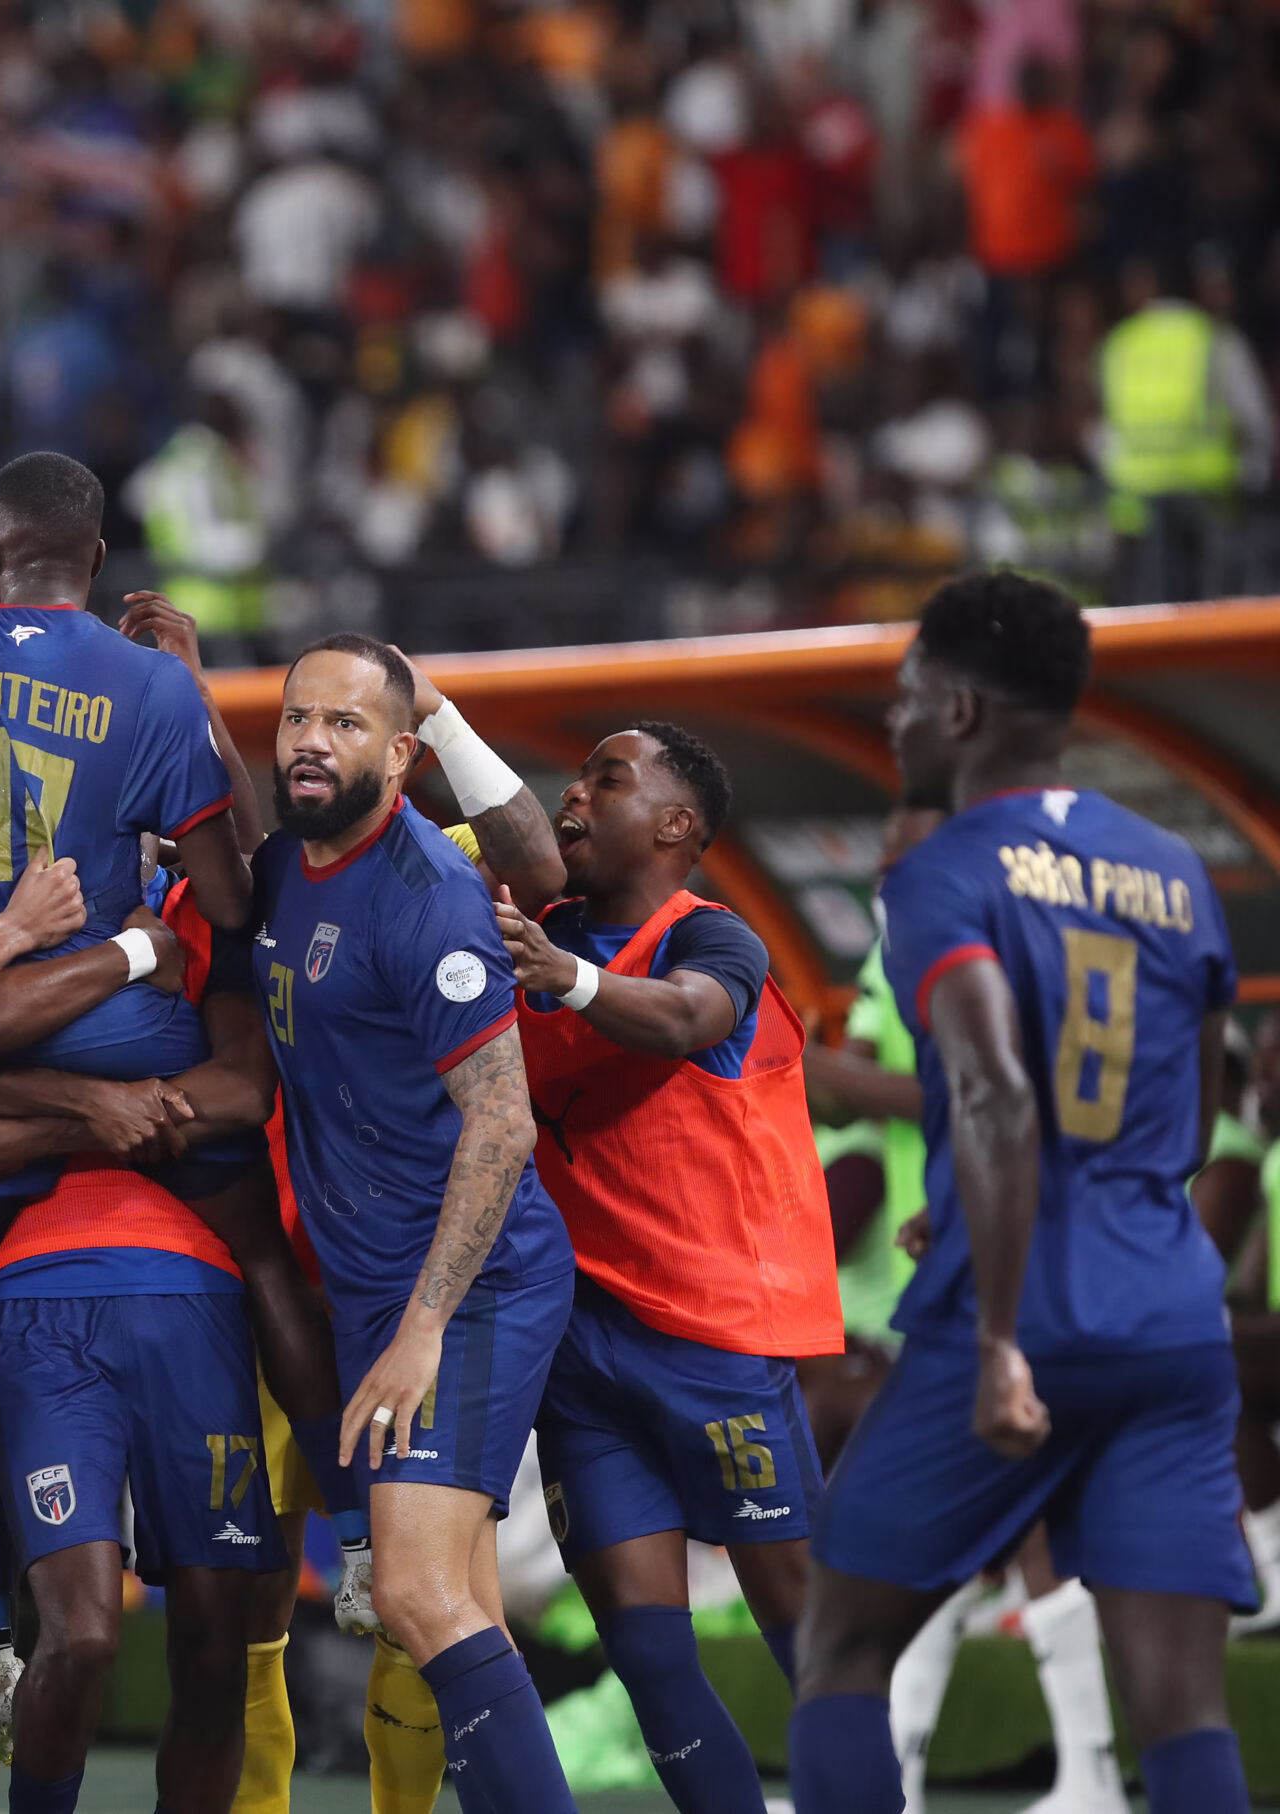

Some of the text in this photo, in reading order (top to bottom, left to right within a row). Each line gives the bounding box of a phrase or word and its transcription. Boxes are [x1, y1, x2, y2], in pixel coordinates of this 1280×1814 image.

[316, 926, 338, 938] FCF
[268, 961, 294, 1047] 21
[1054, 925, 1138, 1143] 8
[206, 1434, 258, 1511] 17
[705, 1413, 777, 1490] 16
[30, 1468, 65, 1486] FCF
[751, 1506, 791, 1520] tempo
[231, 1534, 262, 1546] temp
